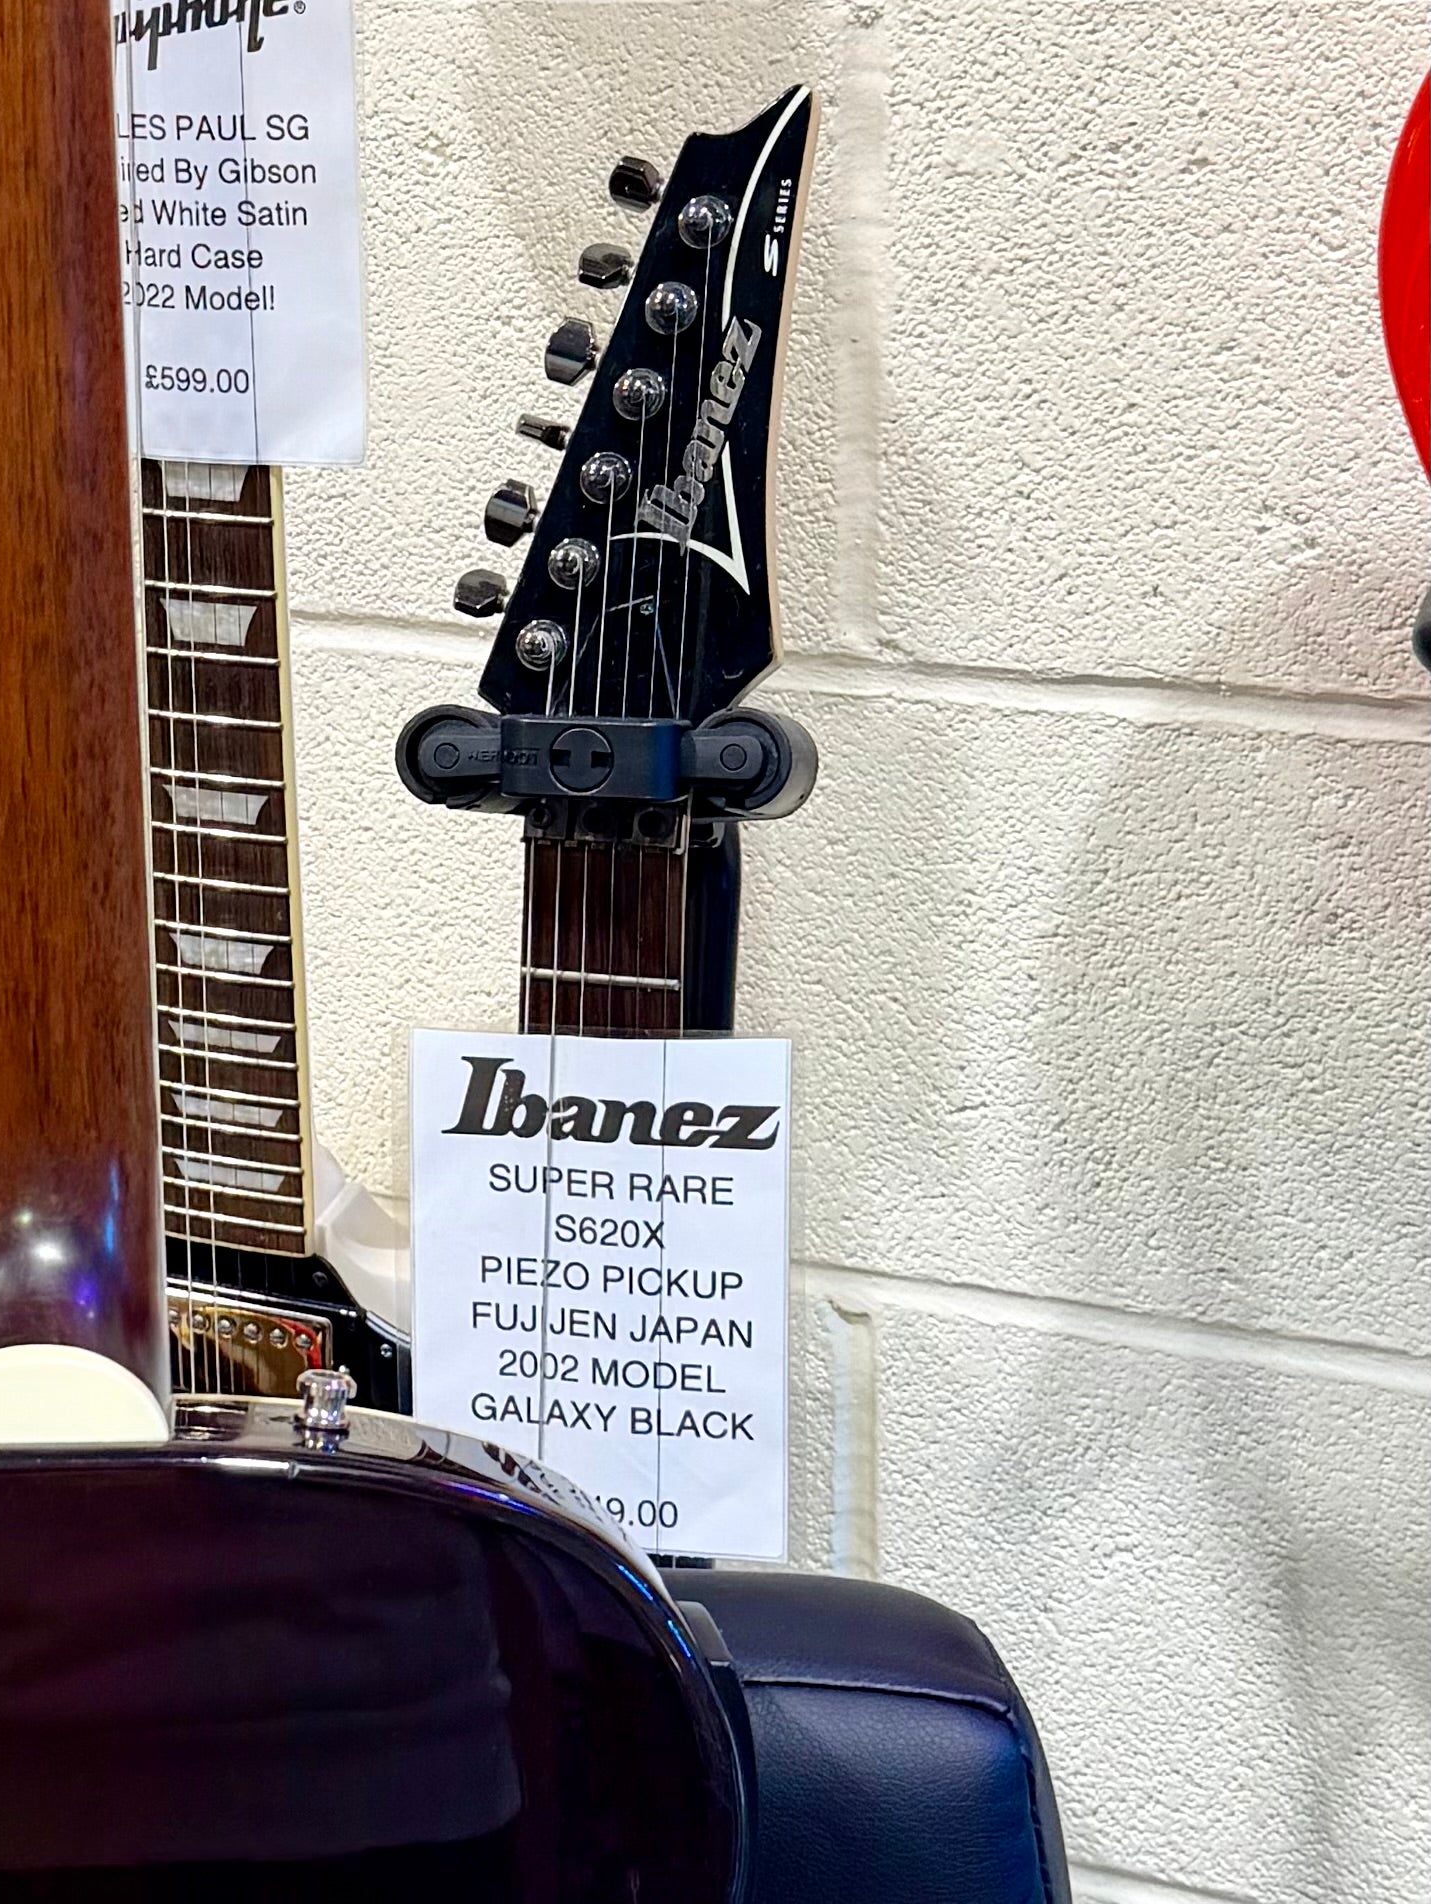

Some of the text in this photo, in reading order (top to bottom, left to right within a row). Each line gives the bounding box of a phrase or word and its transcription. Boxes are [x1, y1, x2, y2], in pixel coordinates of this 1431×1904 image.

[117, 113, 309, 142] LES PAUL SG
[121, 156, 317, 191] ired By Gibson
[152, 199, 226, 227] White
[238, 199, 308, 228] Satin
[773, 178, 792, 234] SERIES
[126, 240, 263, 271] Hard Case
[185, 284, 275, 312] Model!
[144, 364, 250, 394] £599.00
[639, 317, 763, 557] Ibanez
[441, 1056, 781, 1151] Ibanez
[488, 1163, 735, 1206] SUPER RARE
[554, 1214, 666, 1250] S620X
[481, 1255, 743, 1300] PIEZO PICKUP
[472, 1301, 753, 1348] FUJJEN JAPAN
[498, 1349, 726, 1394] 2002 MODEL
[470, 1393, 755, 1441] GALAXY BLACK
[596, 1495, 678, 1529] 9.00
